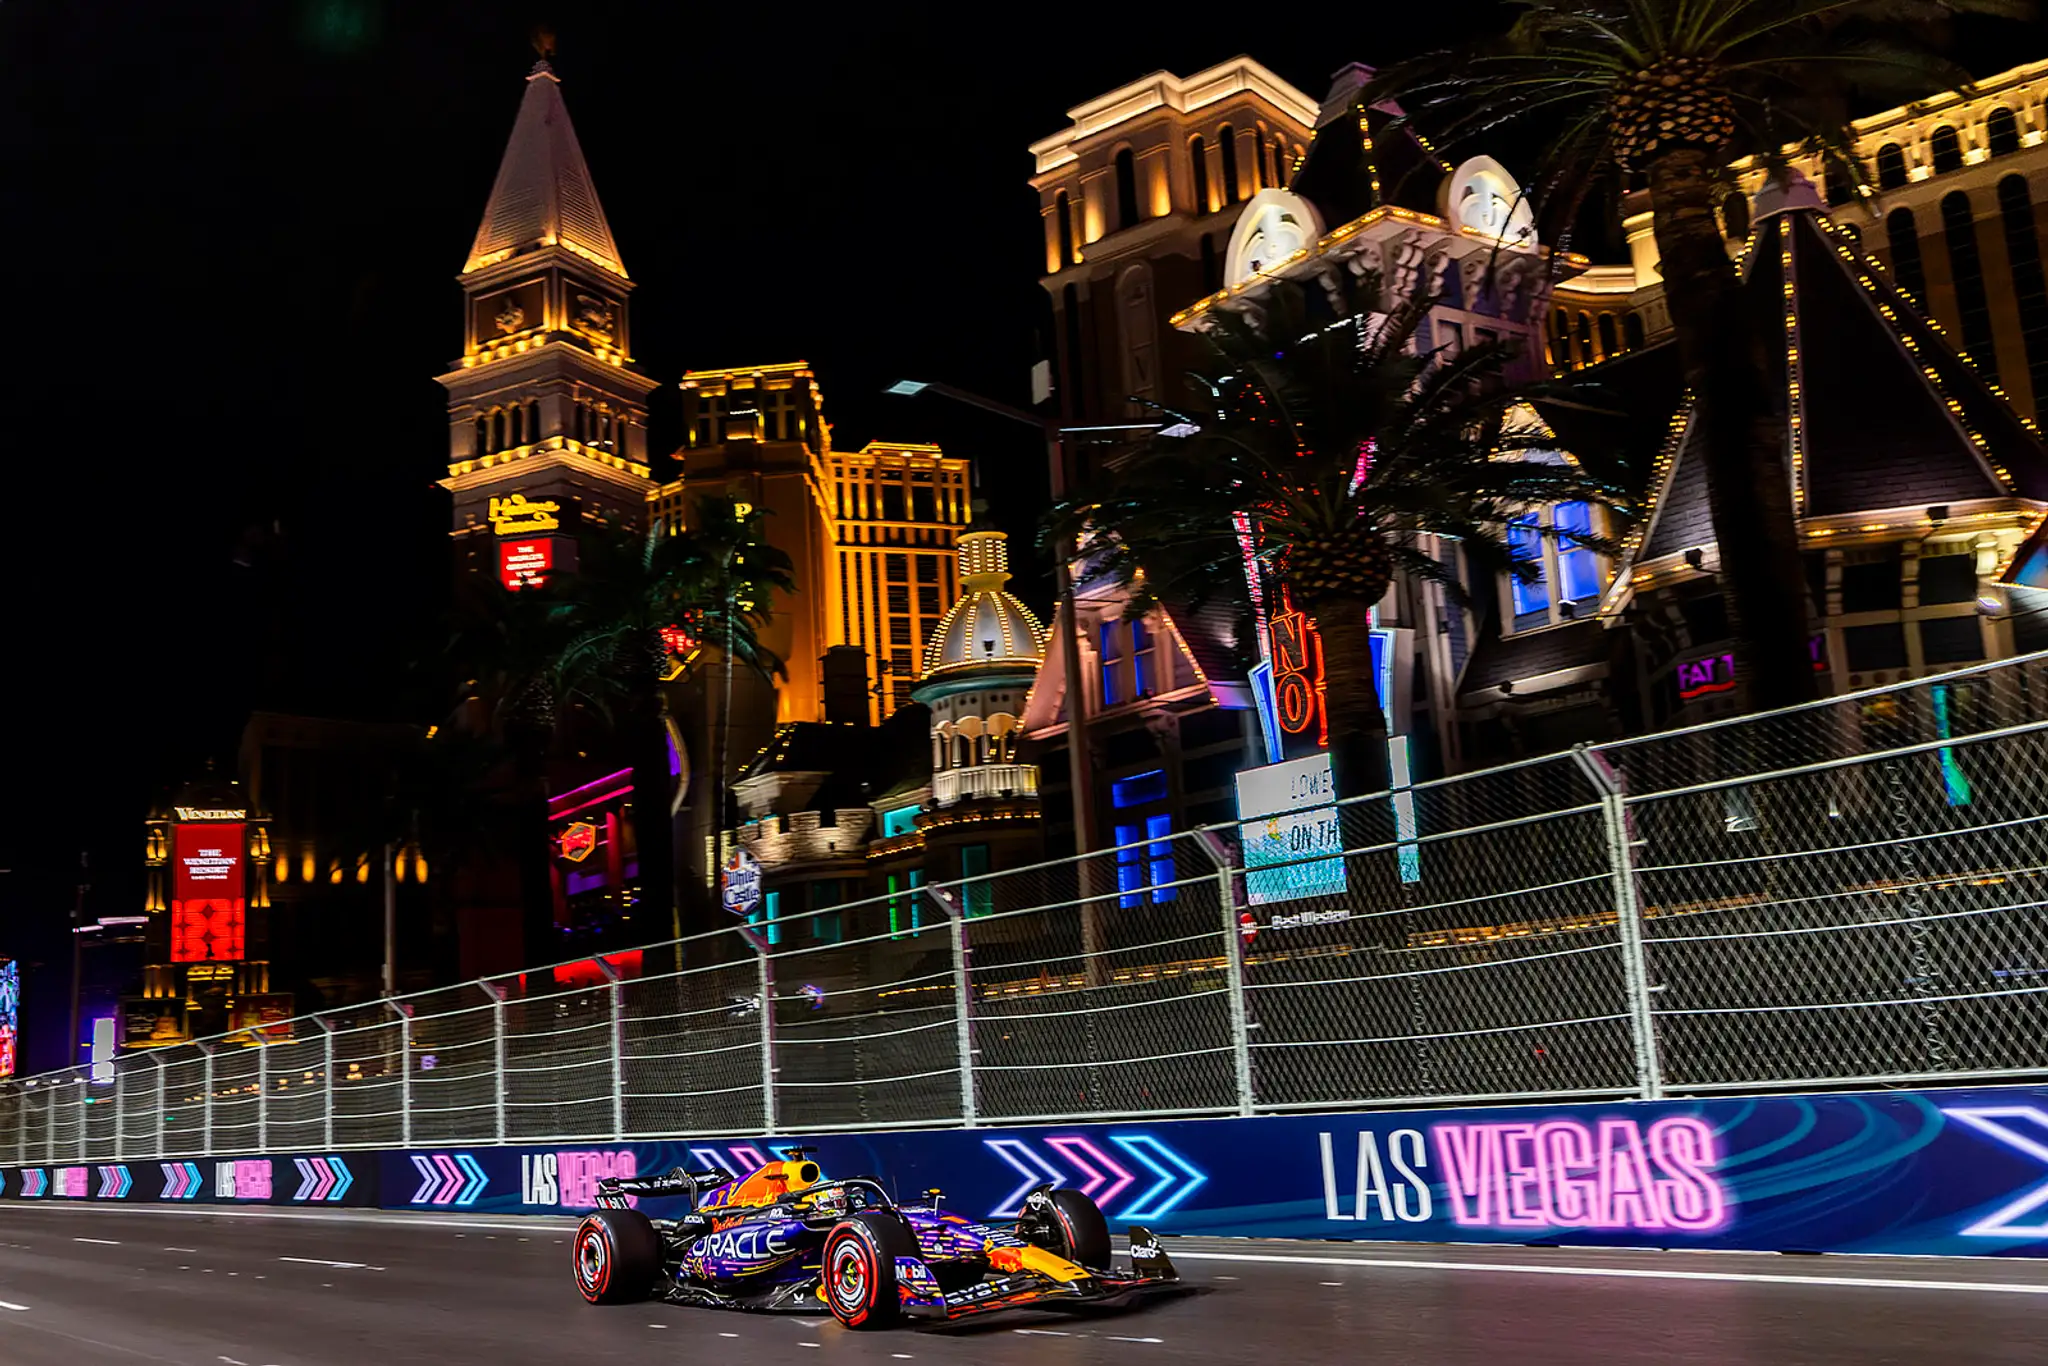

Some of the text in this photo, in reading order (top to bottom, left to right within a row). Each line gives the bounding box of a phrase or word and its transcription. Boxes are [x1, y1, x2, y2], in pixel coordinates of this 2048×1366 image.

[1291, 769, 1335, 800] LOWE
[1290, 817, 1341, 851] ON TH
[521, 1153, 558, 1206] LAS
[1319, 1116, 1724, 1230] LAS VEGAS
[692, 1229, 796, 1260] ORACLE
[895, 1264, 926, 1279] Mobil
